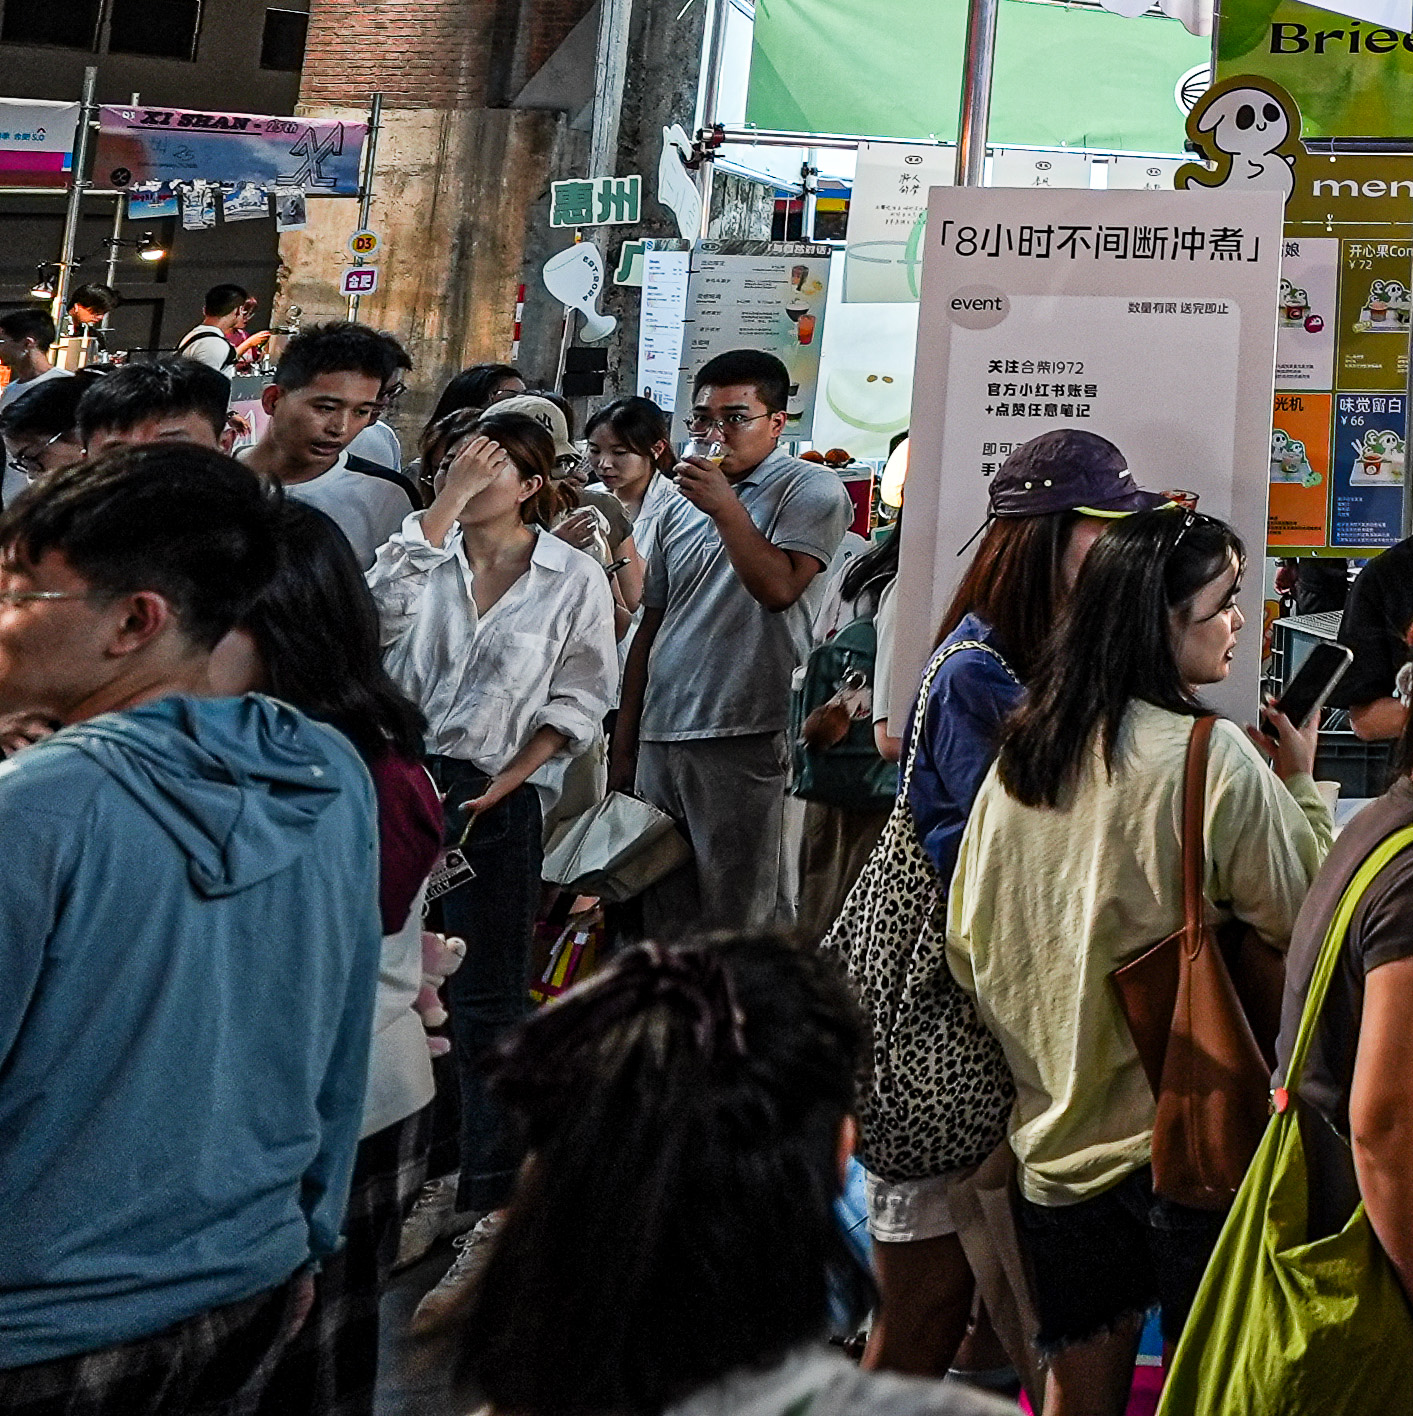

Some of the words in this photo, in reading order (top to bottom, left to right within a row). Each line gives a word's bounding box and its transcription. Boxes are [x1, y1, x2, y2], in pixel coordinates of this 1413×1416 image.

[553, 178, 639, 225] 惠州
[356, 237, 372, 249] D3
[942, 220, 1260, 263] 「8小时不间断冲煮」
[951, 297, 1003, 311] event
[1127, 302, 1177, 315] 数量有限
[1180, 302, 1229, 315] 送完即止
[987, 383, 1098, 398] 官方小红书账号
[985, 403, 1091, 418] +点赞任意笔记
